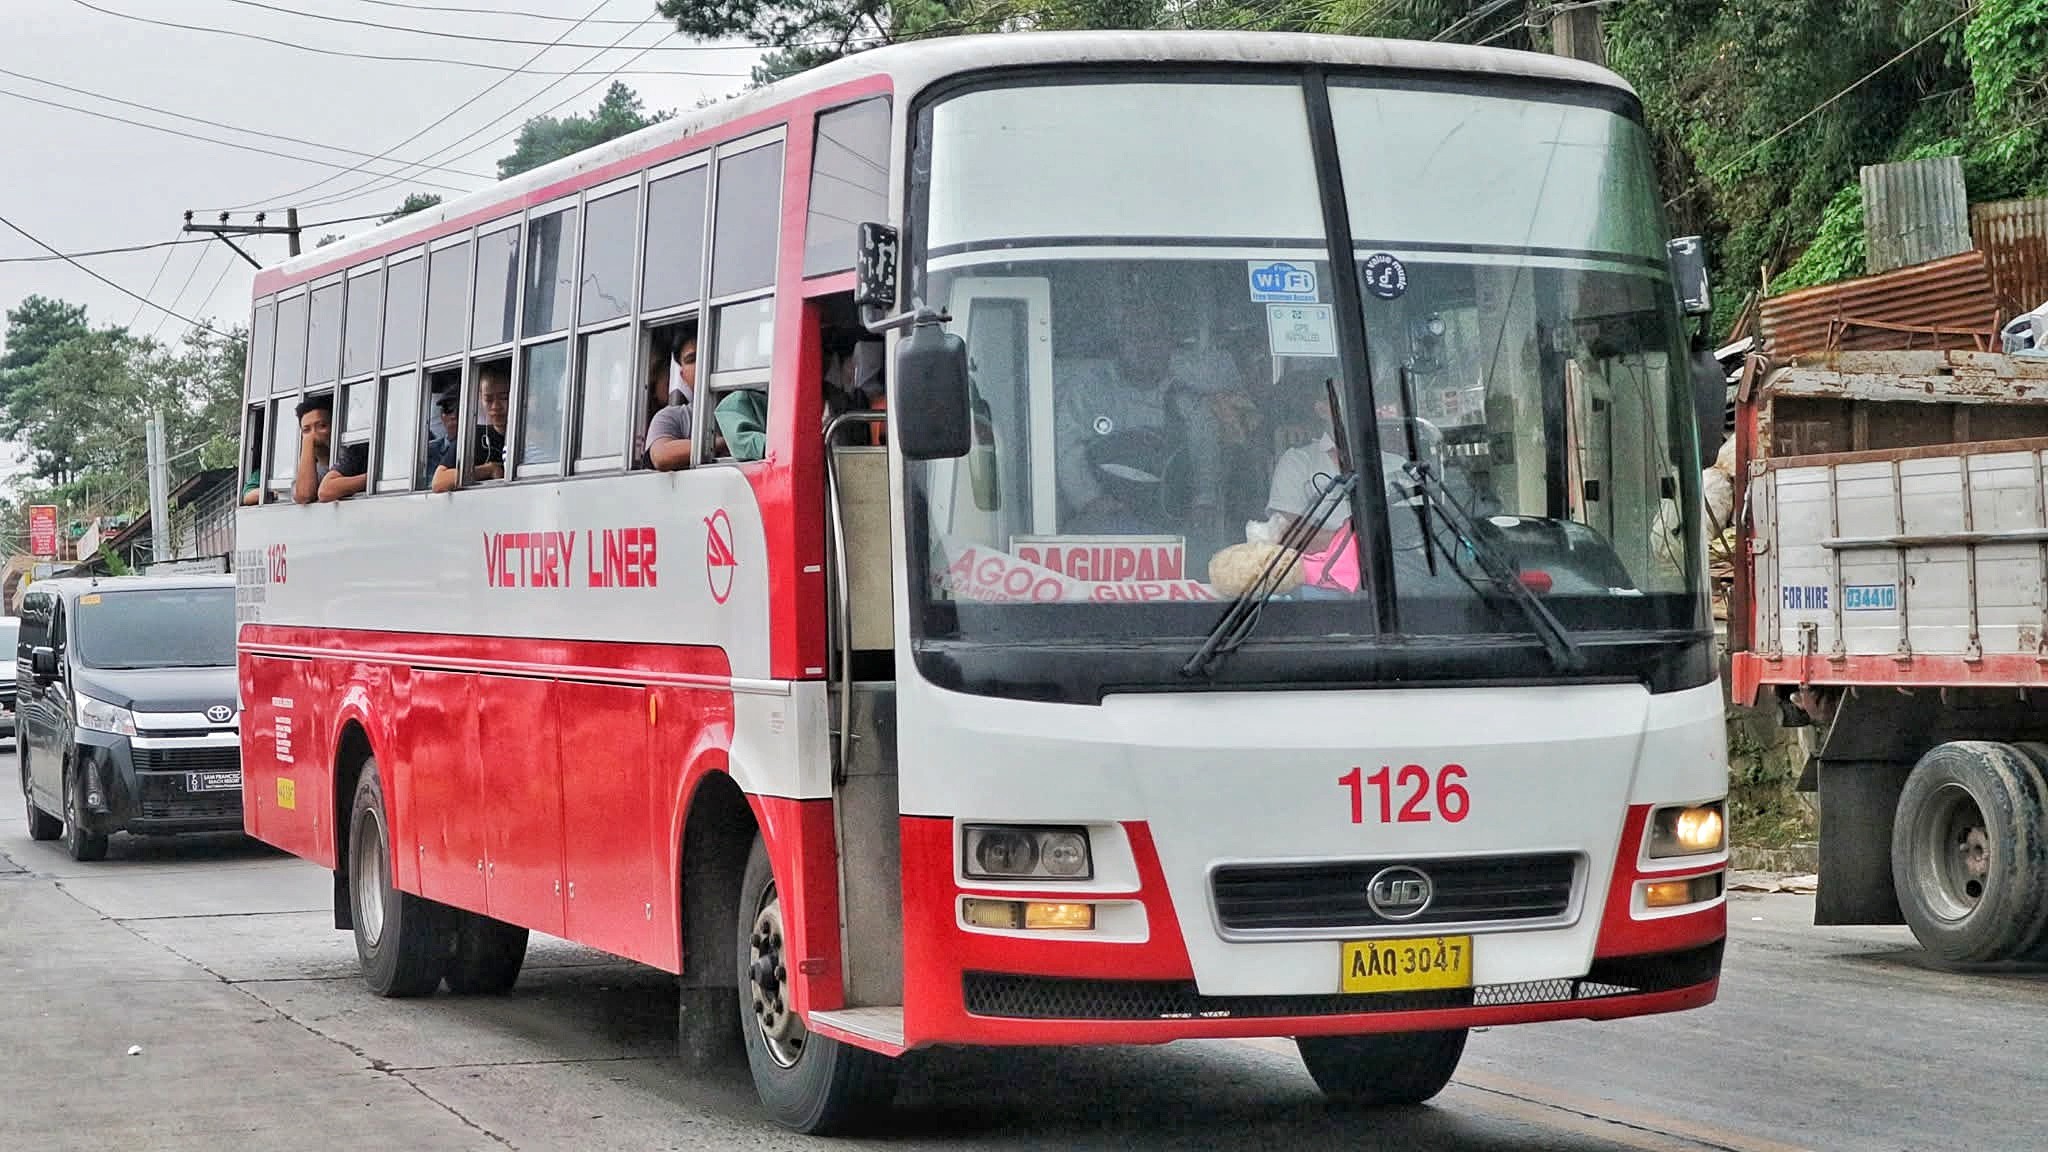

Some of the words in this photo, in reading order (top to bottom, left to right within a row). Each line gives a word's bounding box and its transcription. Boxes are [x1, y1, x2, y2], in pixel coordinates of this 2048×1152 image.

[267, 543, 287, 585] 1126
[483, 530, 576, 588] VICTORY
[587, 526, 657, 588] LINER
[948, 548, 1063, 601] AGOO
[1782, 585, 1802, 609] FOR
[1804, 585, 1828, 609] HIRE
[1847, 587, 1894, 608] 034410
[1338, 764, 1470, 824] 1126
[1371, 879, 1428, 905] UD
